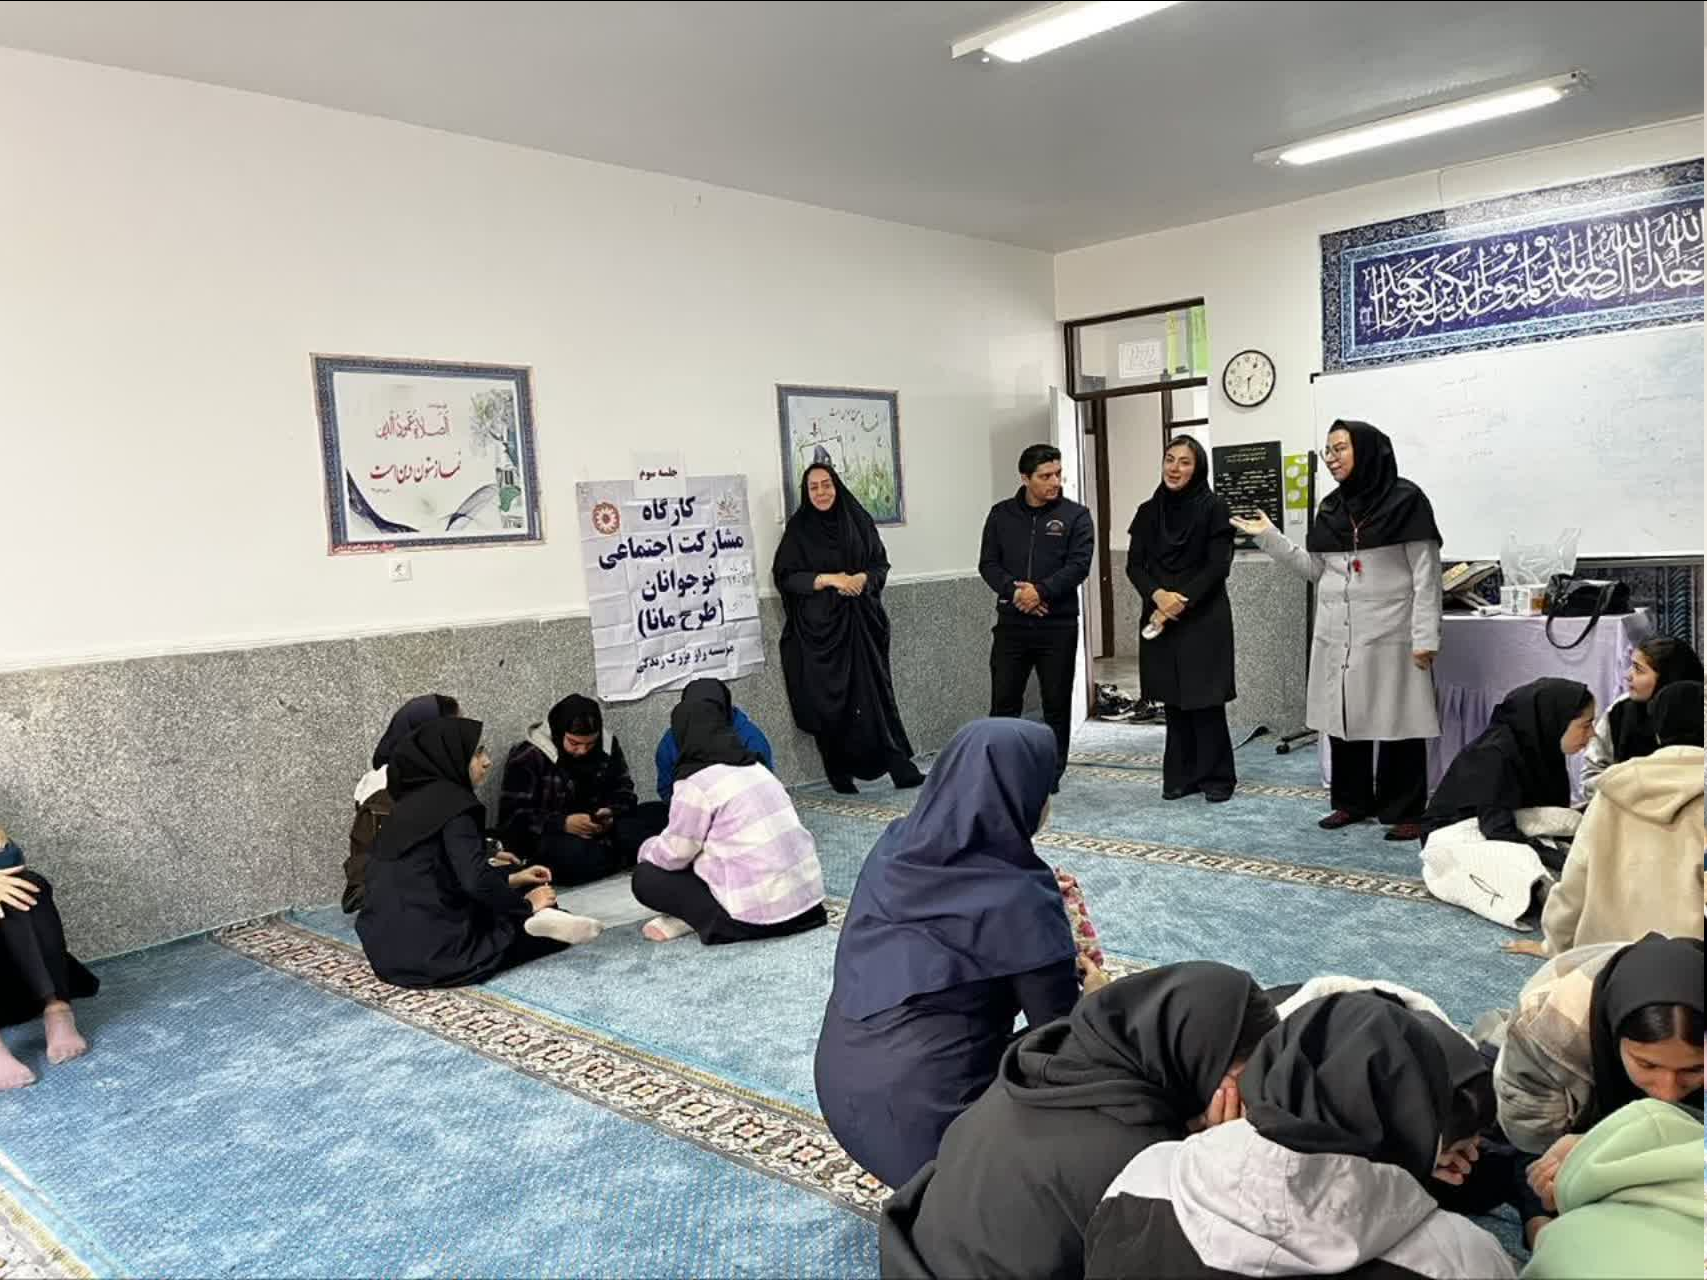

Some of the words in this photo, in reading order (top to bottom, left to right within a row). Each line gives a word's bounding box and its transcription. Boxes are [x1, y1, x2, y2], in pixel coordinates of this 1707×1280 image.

[639, 469, 657, 481] سوم
[658, 466, 678, 479] جلسه
[642, 496, 696, 526] کارگاه
[598, 534, 674, 570] اجتماعی
[678, 528, 744, 558] مشارکت
[641, 564, 716, 601] نوجوانان
